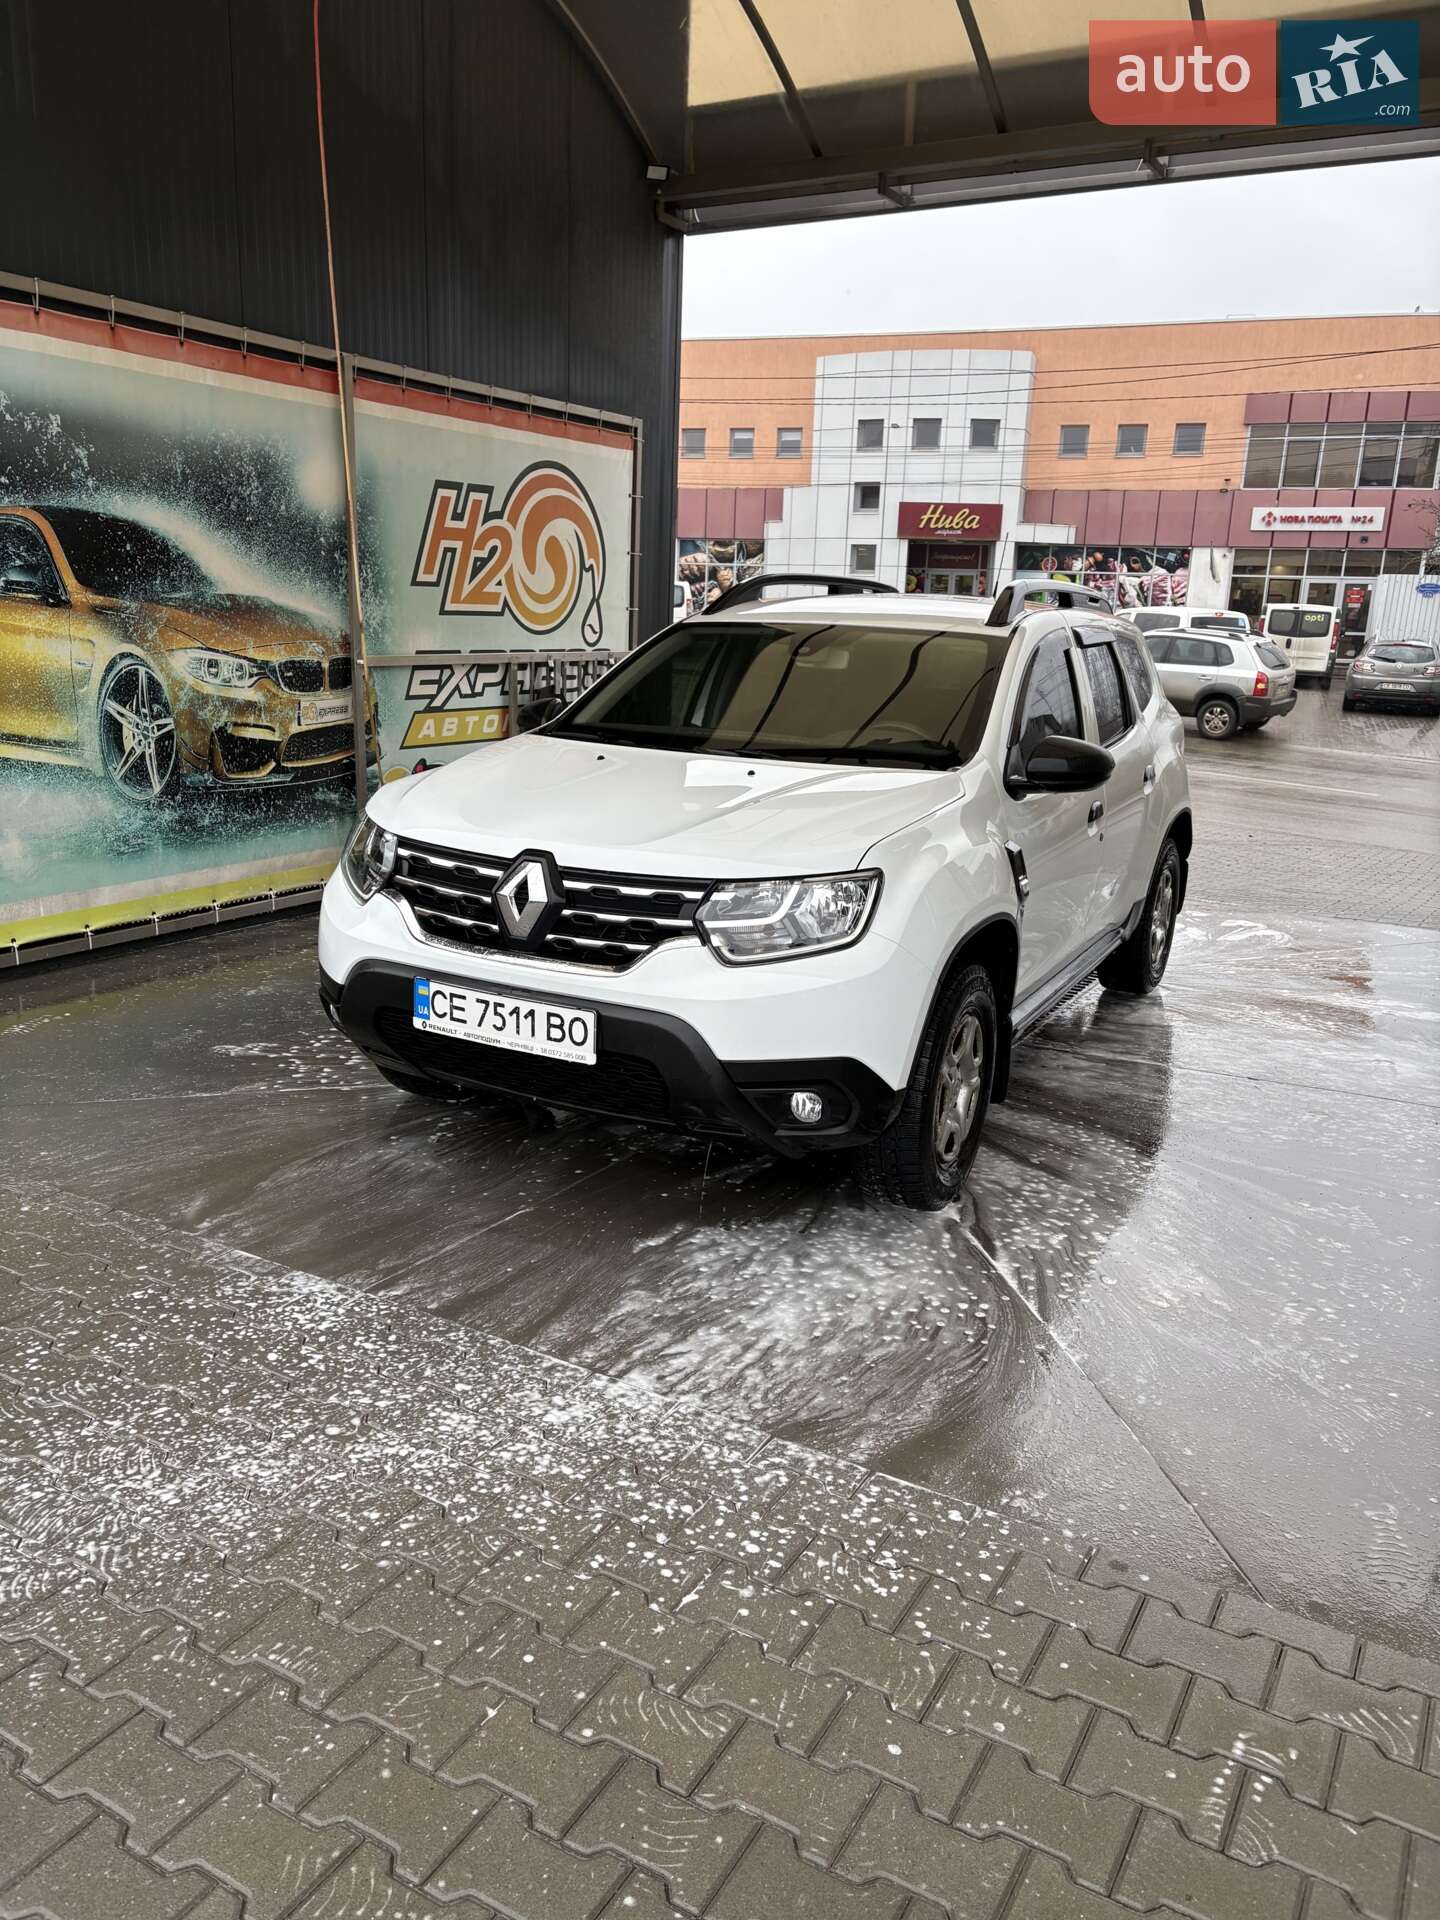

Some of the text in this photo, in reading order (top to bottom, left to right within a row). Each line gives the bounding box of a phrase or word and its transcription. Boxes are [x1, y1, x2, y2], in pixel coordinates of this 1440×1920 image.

[1279, 515, 1306, 525] НОВА
[1307, 515, 1344, 525] ПОШТА
[1304, 613, 1325, 623] opti
[418, 1005, 429, 1015] UA
[431, 990, 589, 1047] CE 7511 BO
[428, 1023, 457, 1035] RENAULT
